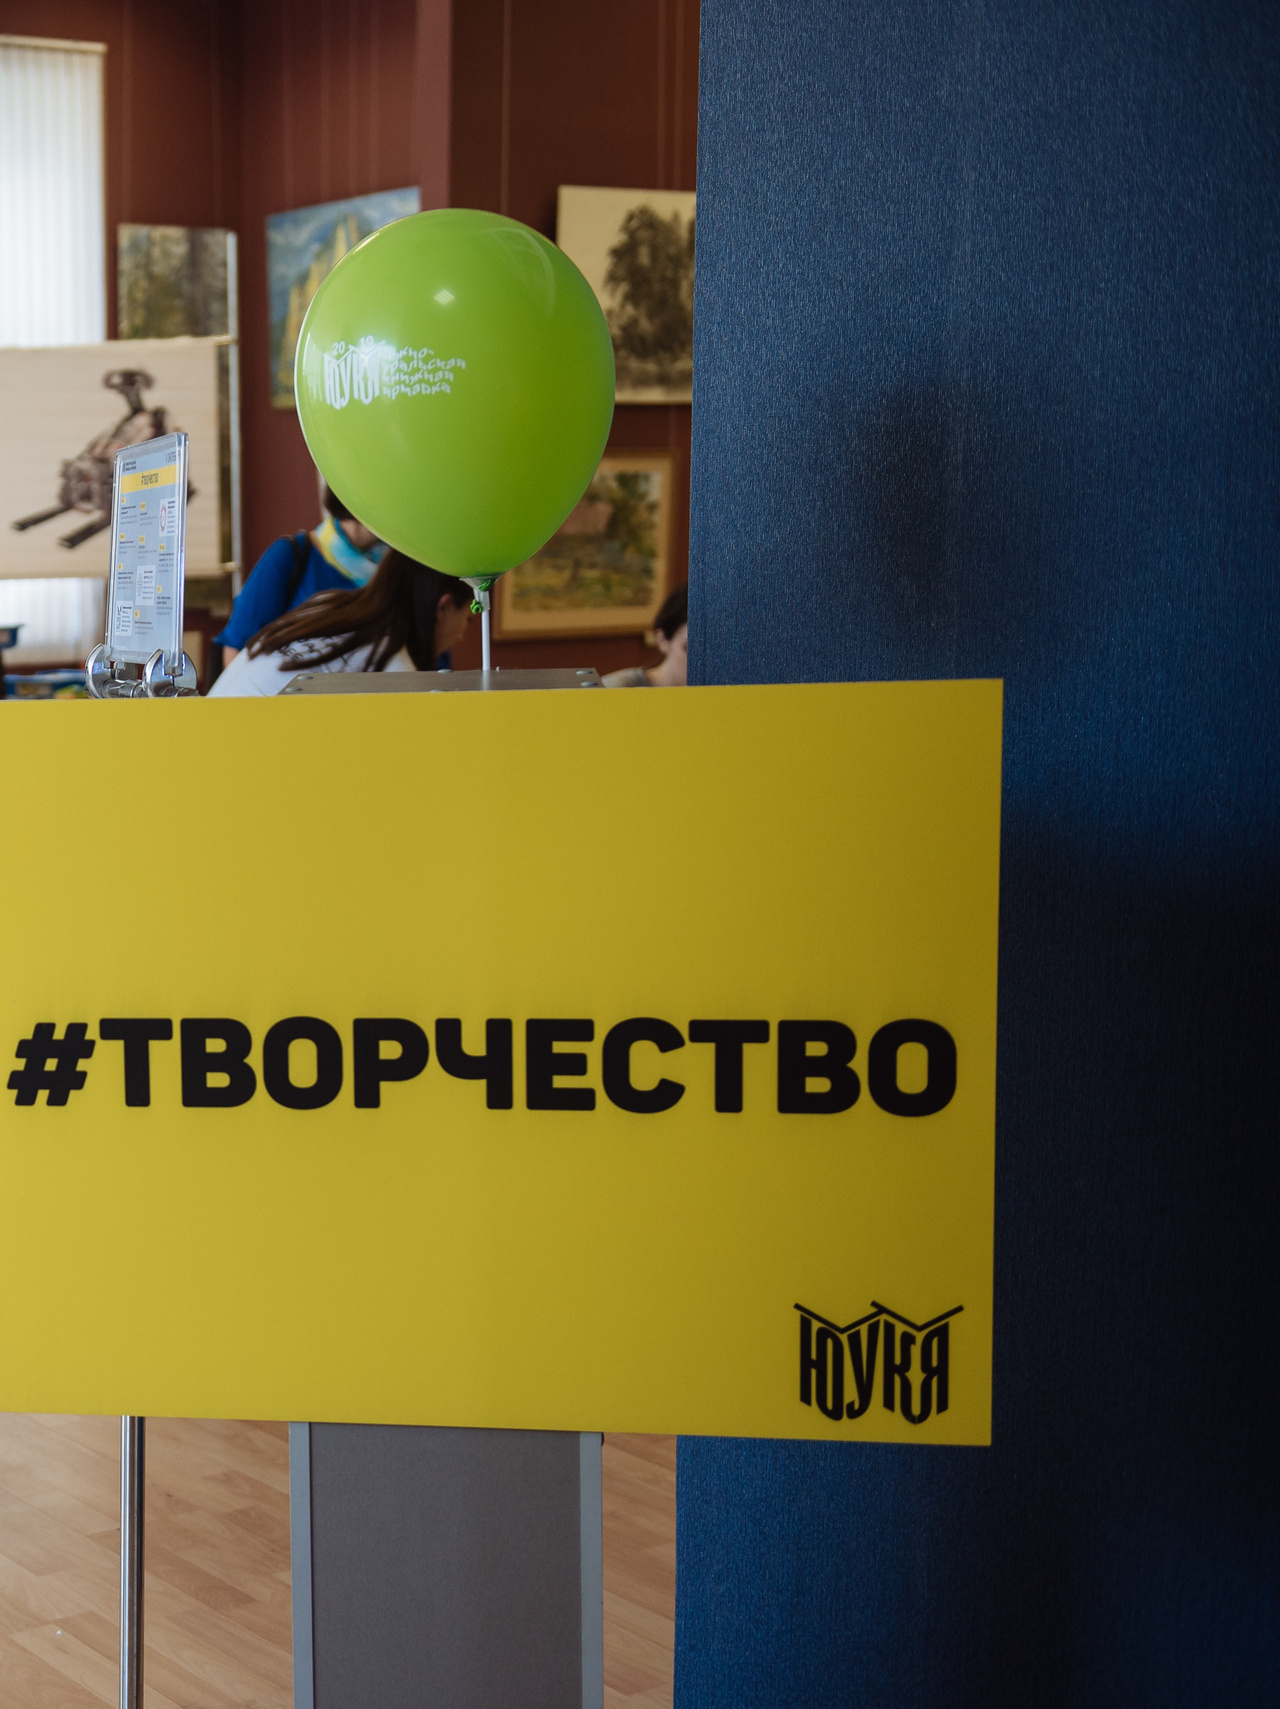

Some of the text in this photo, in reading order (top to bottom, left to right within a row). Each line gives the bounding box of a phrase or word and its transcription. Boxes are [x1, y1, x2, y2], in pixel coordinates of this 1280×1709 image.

[332, 341, 346, 355] 20
[7, 1015, 957, 1118] #ТВОРЧЕСТВО
[798, 1310, 951, 1426] ЮУКЯ
